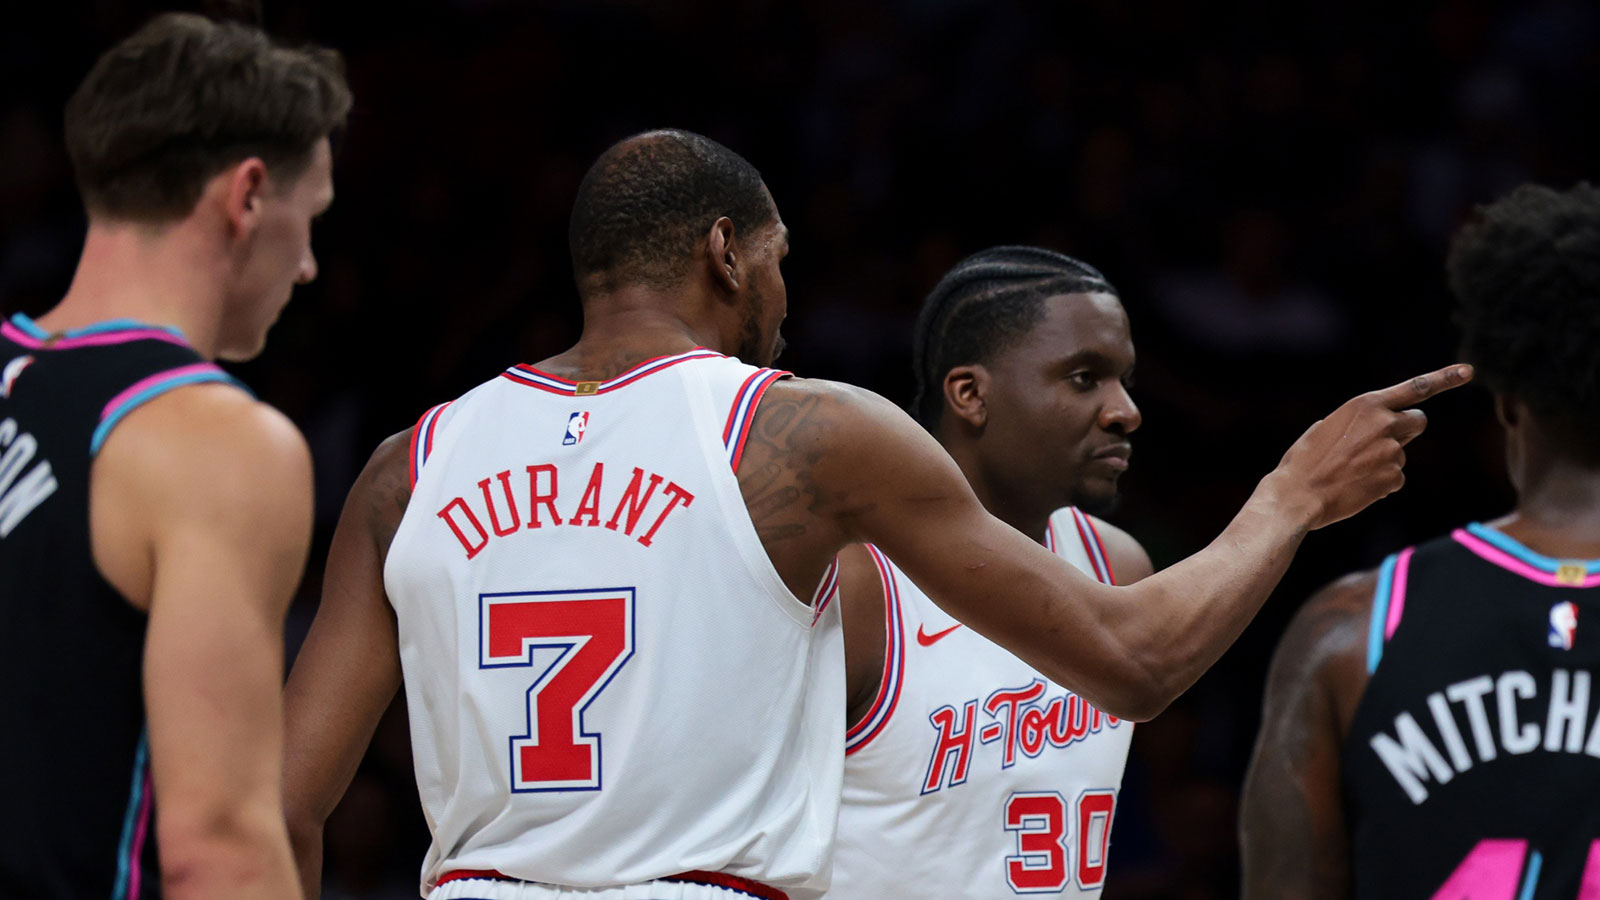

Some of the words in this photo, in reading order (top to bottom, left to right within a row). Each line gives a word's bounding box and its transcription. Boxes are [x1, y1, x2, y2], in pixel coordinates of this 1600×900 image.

[437, 462, 695, 560] DURANT
[478, 586, 636, 793] 7
[1370, 668, 1600, 805] MITCH
[1004, 788, 1116, 894] 30
